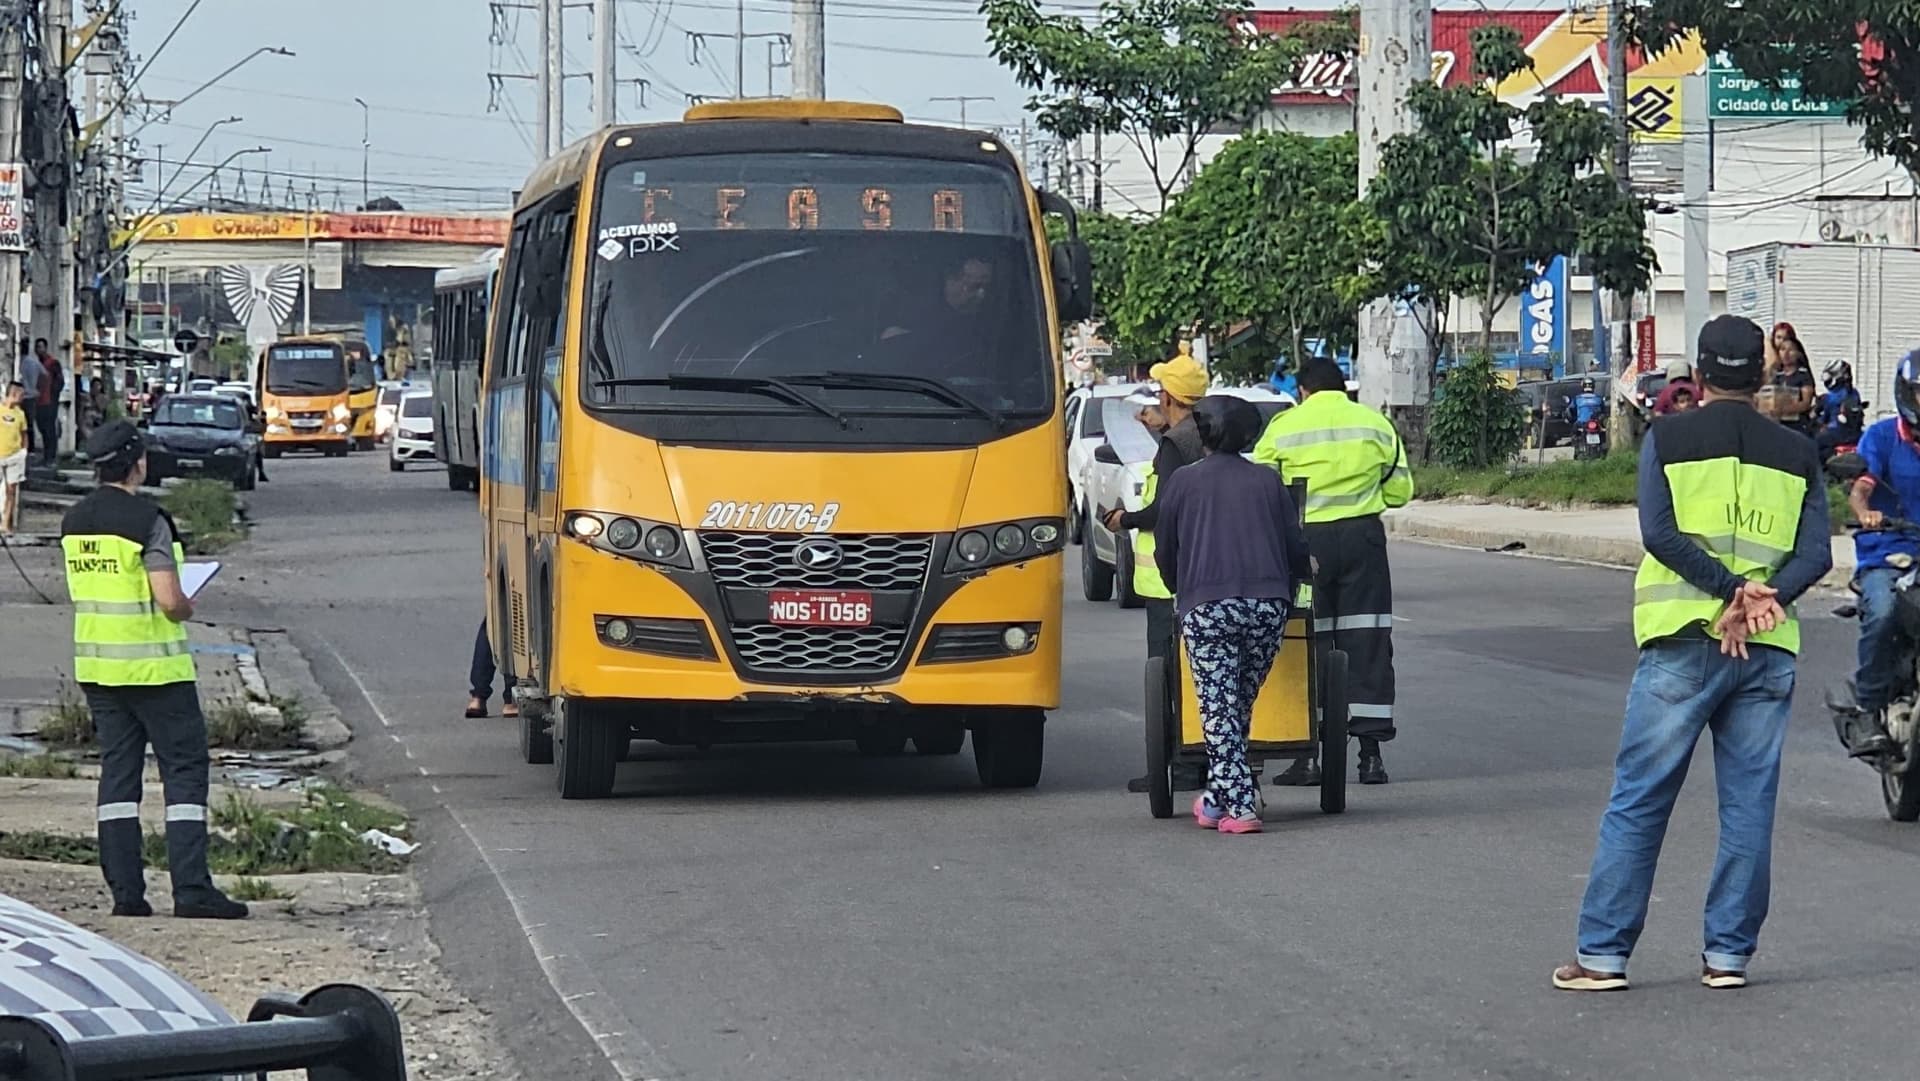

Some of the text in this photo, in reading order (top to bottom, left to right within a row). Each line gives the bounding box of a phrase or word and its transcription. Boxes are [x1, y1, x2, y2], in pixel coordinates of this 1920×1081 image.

[1718, 99, 1768, 112] Cidade
[1771, 99, 1789, 111] de
[644, 188, 966, 232] CEASA
[599, 222, 678, 241] ACEITAMOS
[629, 234, 680, 259] pix
[1528, 279, 1554, 354] GAS
[700, 501, 839, 533] 2011/076-B
[1726, 502, 1775, 536] IMU
